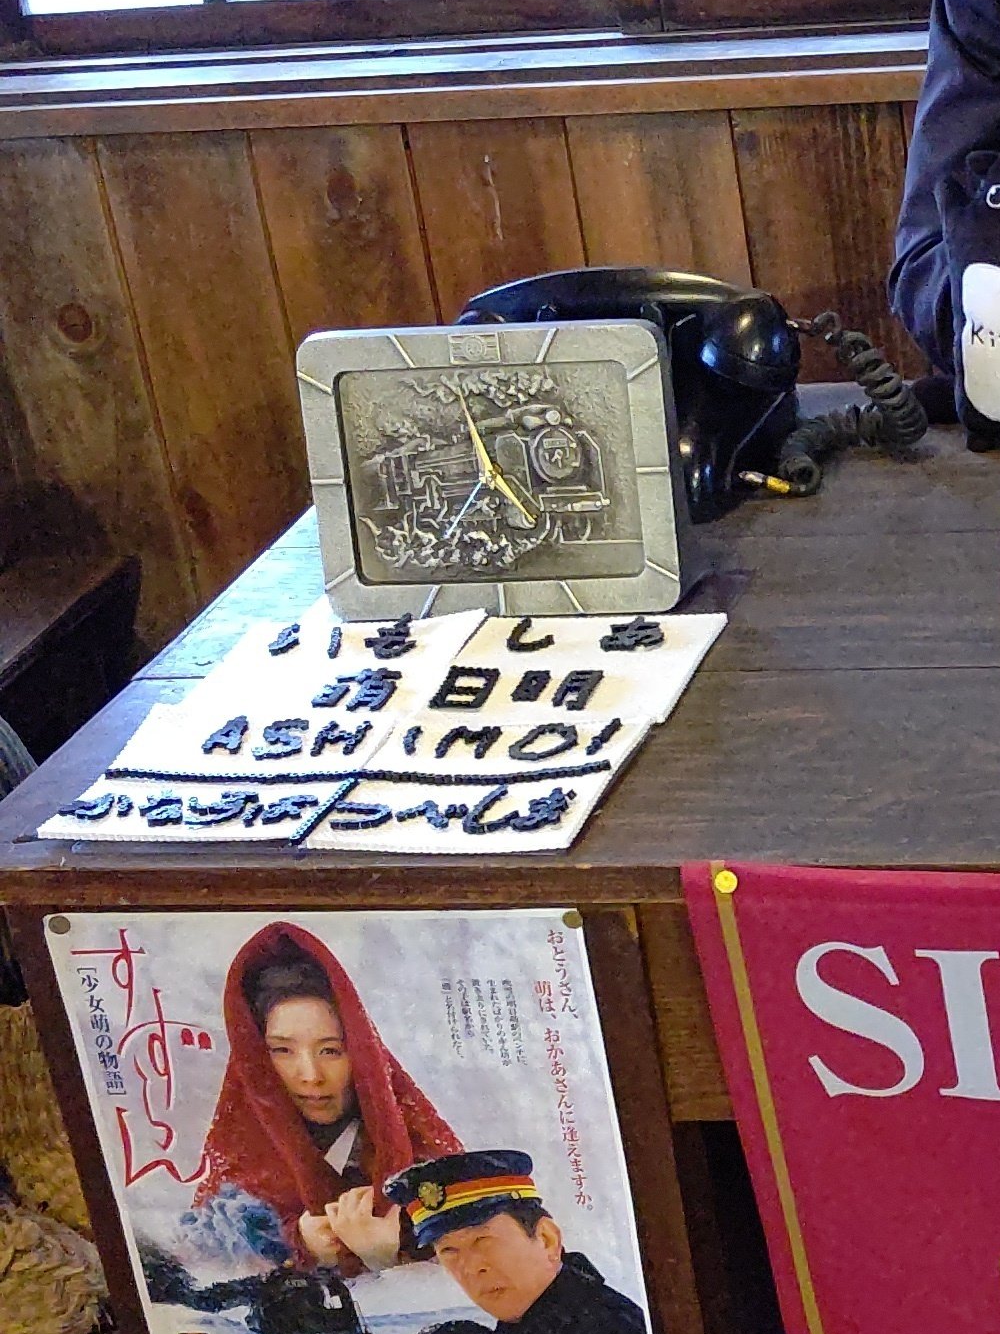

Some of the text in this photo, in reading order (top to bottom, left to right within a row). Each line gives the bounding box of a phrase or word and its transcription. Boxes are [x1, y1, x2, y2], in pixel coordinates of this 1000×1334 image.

[70, 928, 212, 1188] すずらん
[547, 929, 579, 1020] おとうさん、
